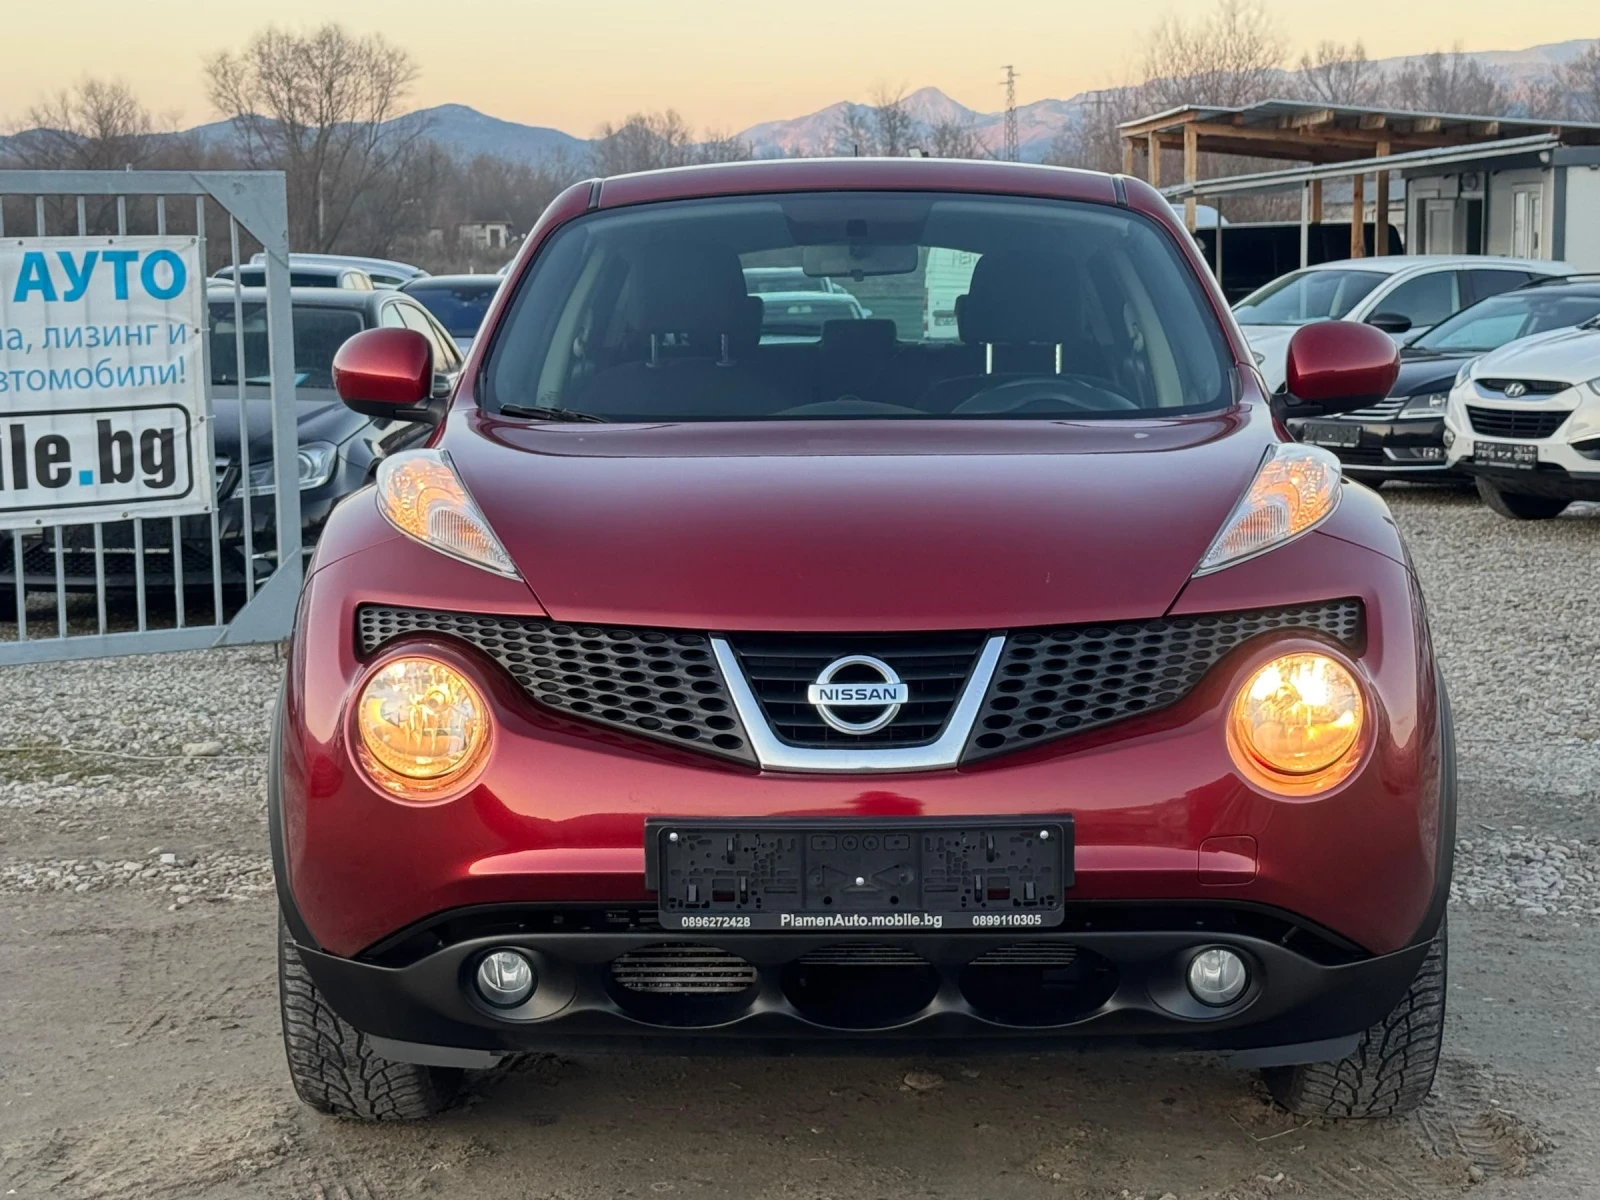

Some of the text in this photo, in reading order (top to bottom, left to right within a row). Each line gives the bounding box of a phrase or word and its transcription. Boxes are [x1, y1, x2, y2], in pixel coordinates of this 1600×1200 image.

[13, 249, 187, 302] АУТО
[0, 323, 186, 354] а, лизинг и
[819, 688, 897, 700] NISSAN
[681, 913, 1042, 929] 0896272428 PlamenAuto.mobile.bg 0899110305
